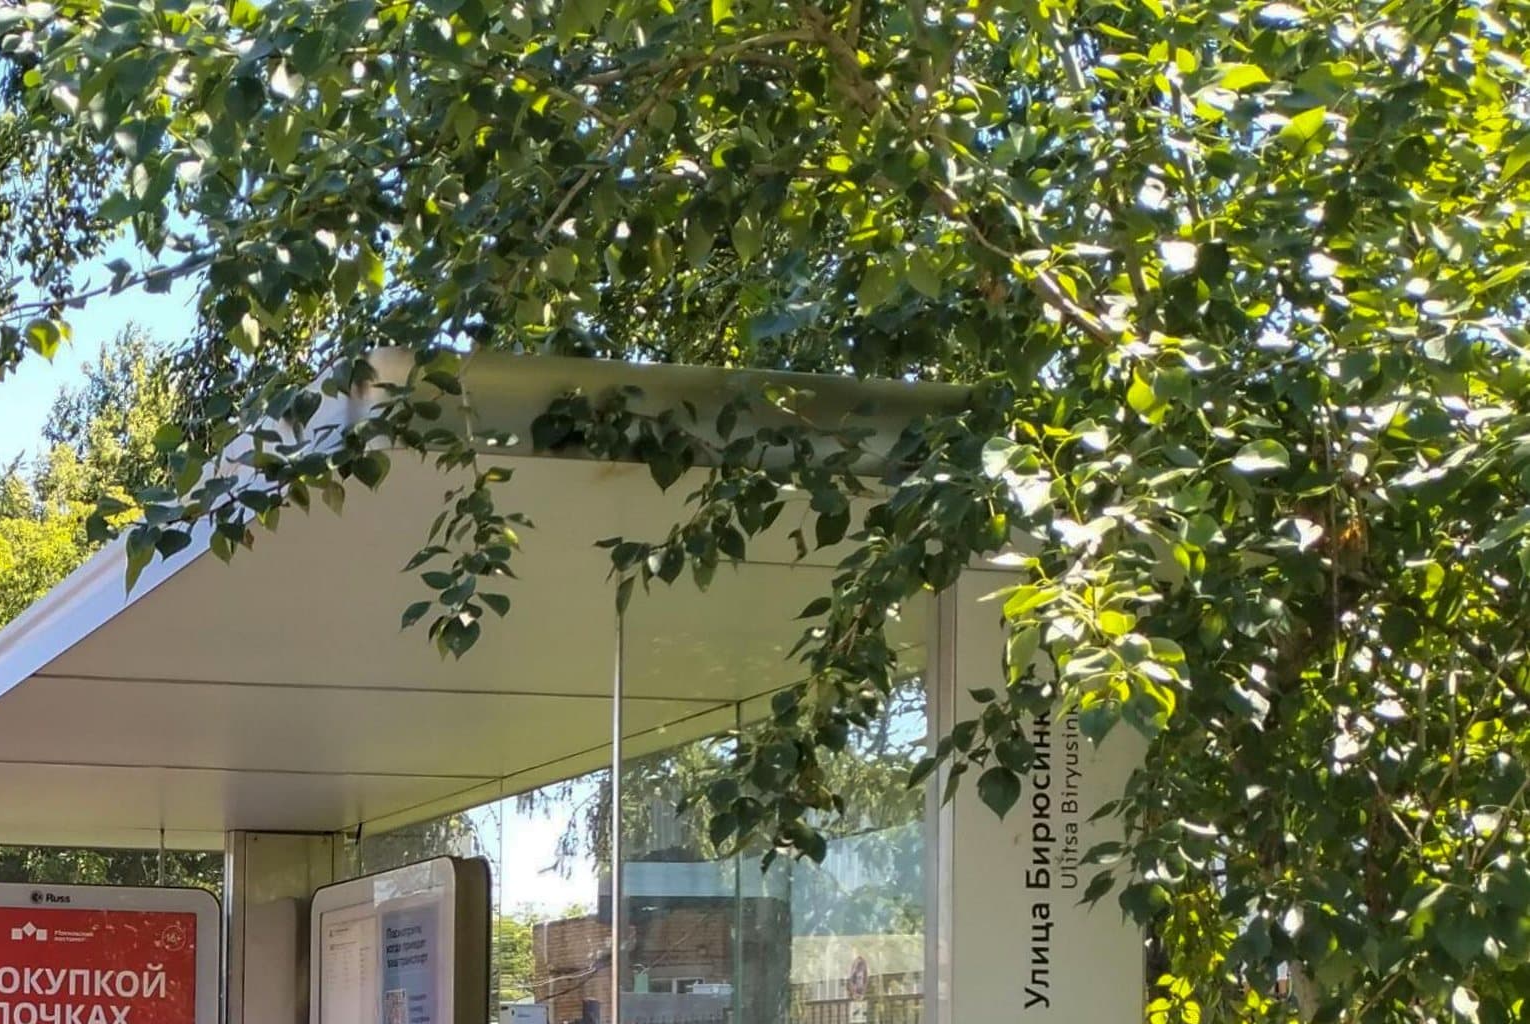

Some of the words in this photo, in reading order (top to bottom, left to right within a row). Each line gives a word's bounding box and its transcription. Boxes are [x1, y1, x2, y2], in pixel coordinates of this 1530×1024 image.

[1061, 703, 1082, 814] Biryusink
[46, 893, 71, 903] Russ
[1061, 821, 1079, 889] Ulitsa
[1024, 901, 1054, 1010] Улица
